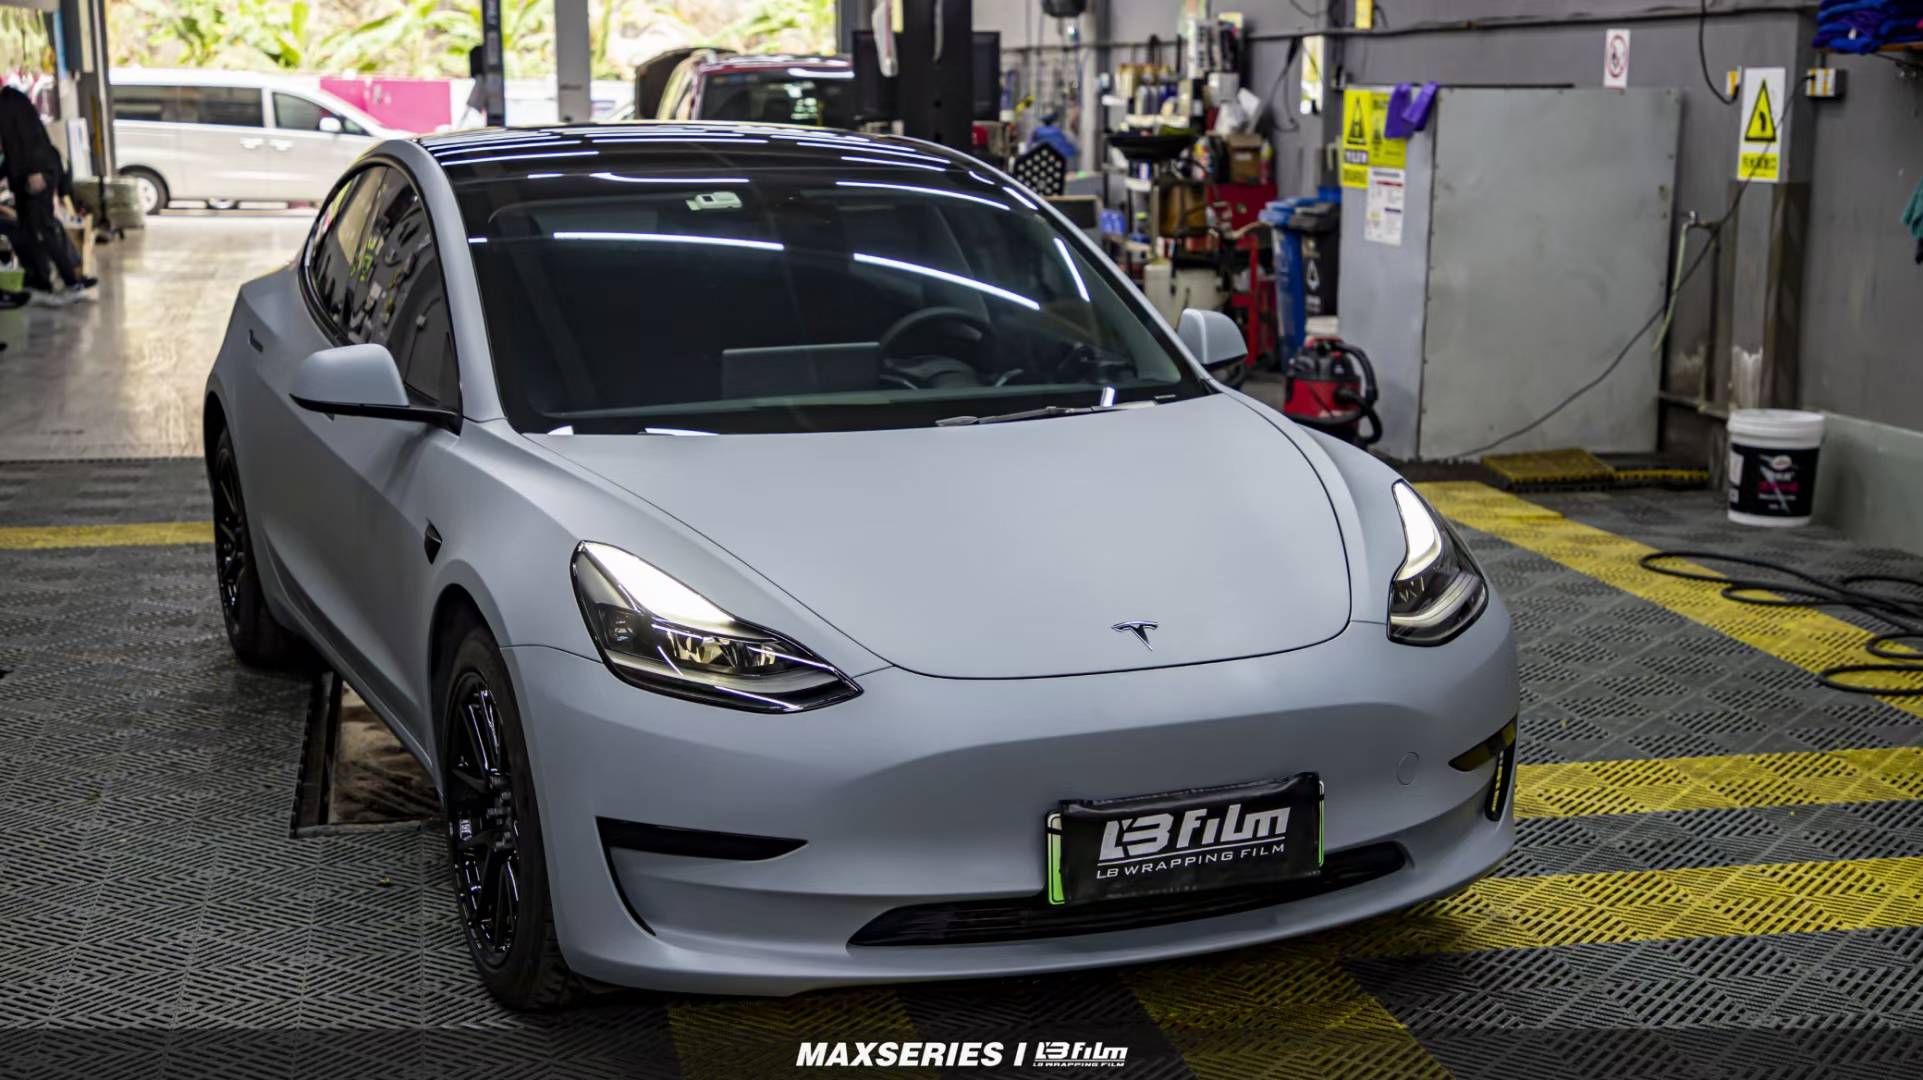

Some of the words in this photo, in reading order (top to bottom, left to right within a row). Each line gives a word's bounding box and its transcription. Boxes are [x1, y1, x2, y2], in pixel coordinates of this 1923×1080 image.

[1096, 868, 1119, 879] LB
[1124, 851, 1234, 876] WRAPPING
[1240, 843, 1286, 859] FILM
